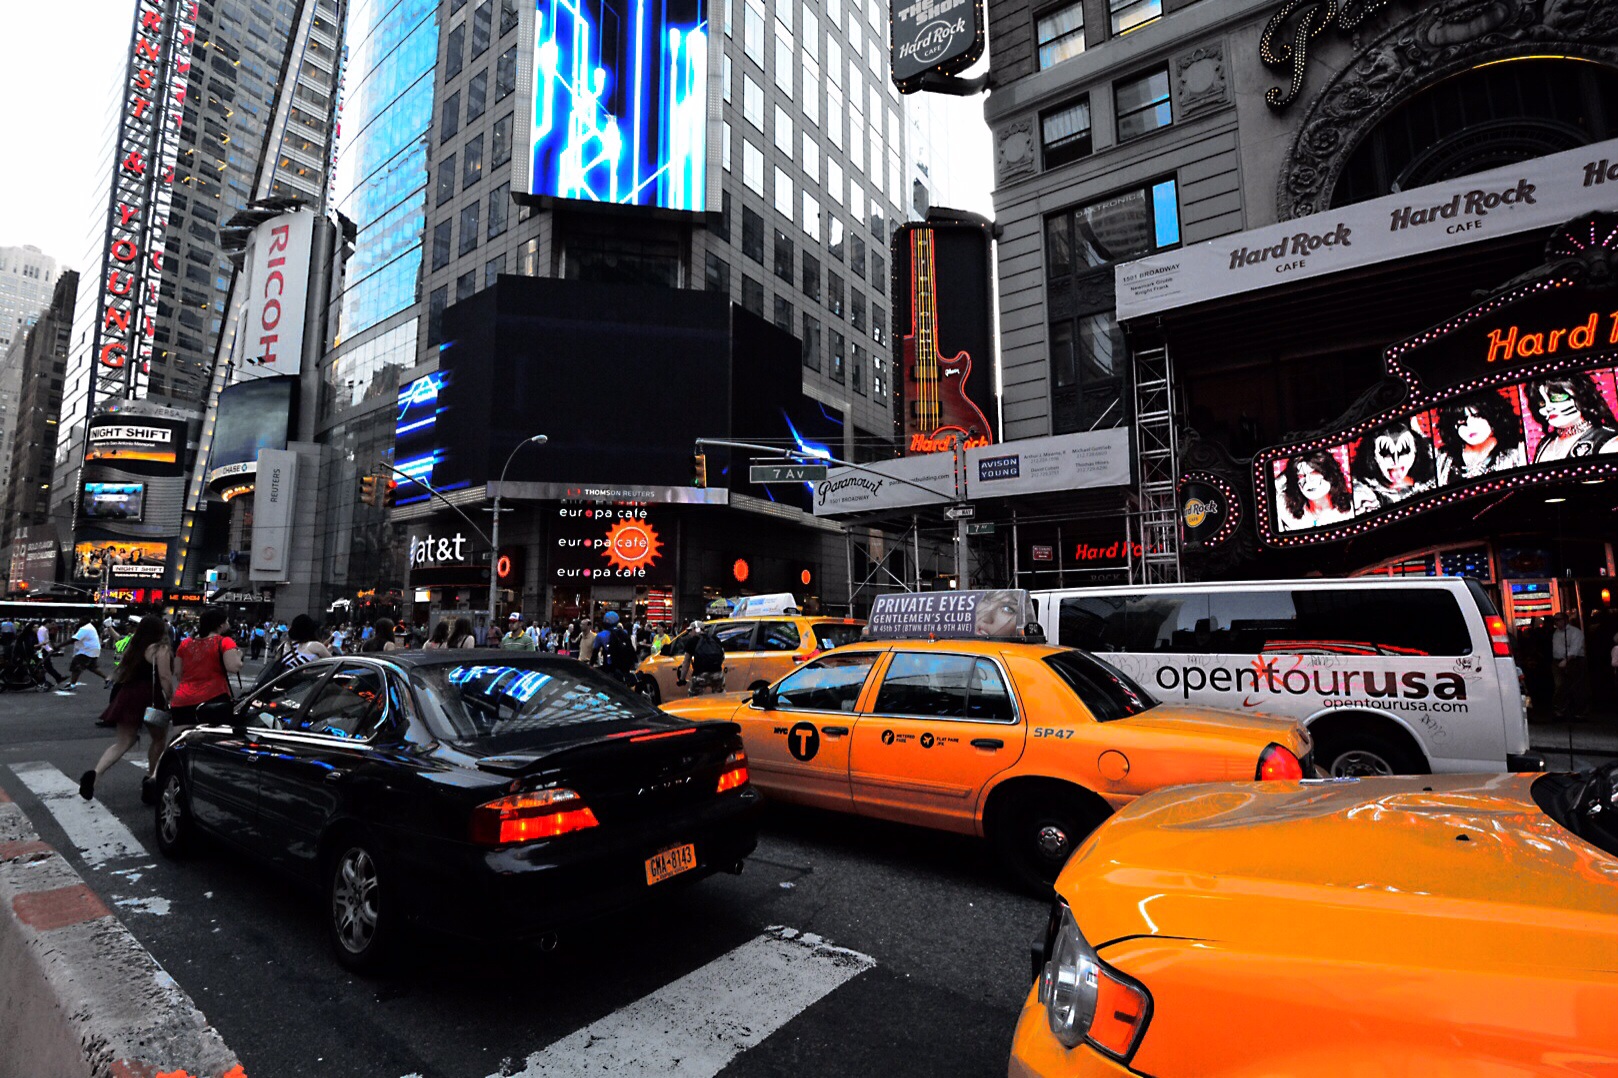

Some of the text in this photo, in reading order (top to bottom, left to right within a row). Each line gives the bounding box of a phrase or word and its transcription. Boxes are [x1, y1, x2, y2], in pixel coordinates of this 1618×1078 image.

[899, 17, 966, 59] Hard Rock
[135, 0, 162, 117] RNST
[924, 44, 942, 57] CAFE
[1390, 178, 1536, 231] Hard Rock
[1446, 219, 1482, 235] CAFE
[1229, 223, 1352, 270] Hard Rock
[1123, 263, 1180, 283] 1501 BROADWAY
[1275, 260, 1306, 273] CAFE
[101, 204, 139, 367] YOUNG
[259, 224, 289, 365] RICOH
[1487, 312, 1598, 362] Hard
[92, 427, 169, 440] NIGHT SHIFT
[910, 434, 950, 452] Hard
[223, 466, 240, 474] CHASE
[981, 459, 1017, 469] AVISON
[773, 468, 804, 478] 7 Av
[981, 468, 1017, 478] YOUNG
[270, 468, 281, 502] REUTERS
[818, 476, 884, 506] Paramount
[841, 495, 870, 504] BROADWAY
[1192, 500, 1217, 514] Rock
[559, 508, 648, 519] europa café
[416, 533, 466, 563] at&t
[558, 537, 648, 549] europa café
[1075, 541, 1119, 560] Hard
[557, 567, 646, 580] europa café
[223, 593, 271, 602] CHASE
[876, 595, 976, 613] PRIVATE EYES
[873, 612, 972, 624] GENTLEMEN'S CLUB
[894, 624, 902, 632] ST
[902, 624, 922, 632] (BTWN
[923, 624, 935, 632] 8TH
[936, 624, 942, 632] &
[943, 624, 956, 632] 9TH
[957, 623, 972, 632] AVE)
[1156, 663, 1467, 700] opentourusa
[1323, 698, 1468, 713] opentourusa.com
[774, 726, 812, 756] NYC T
